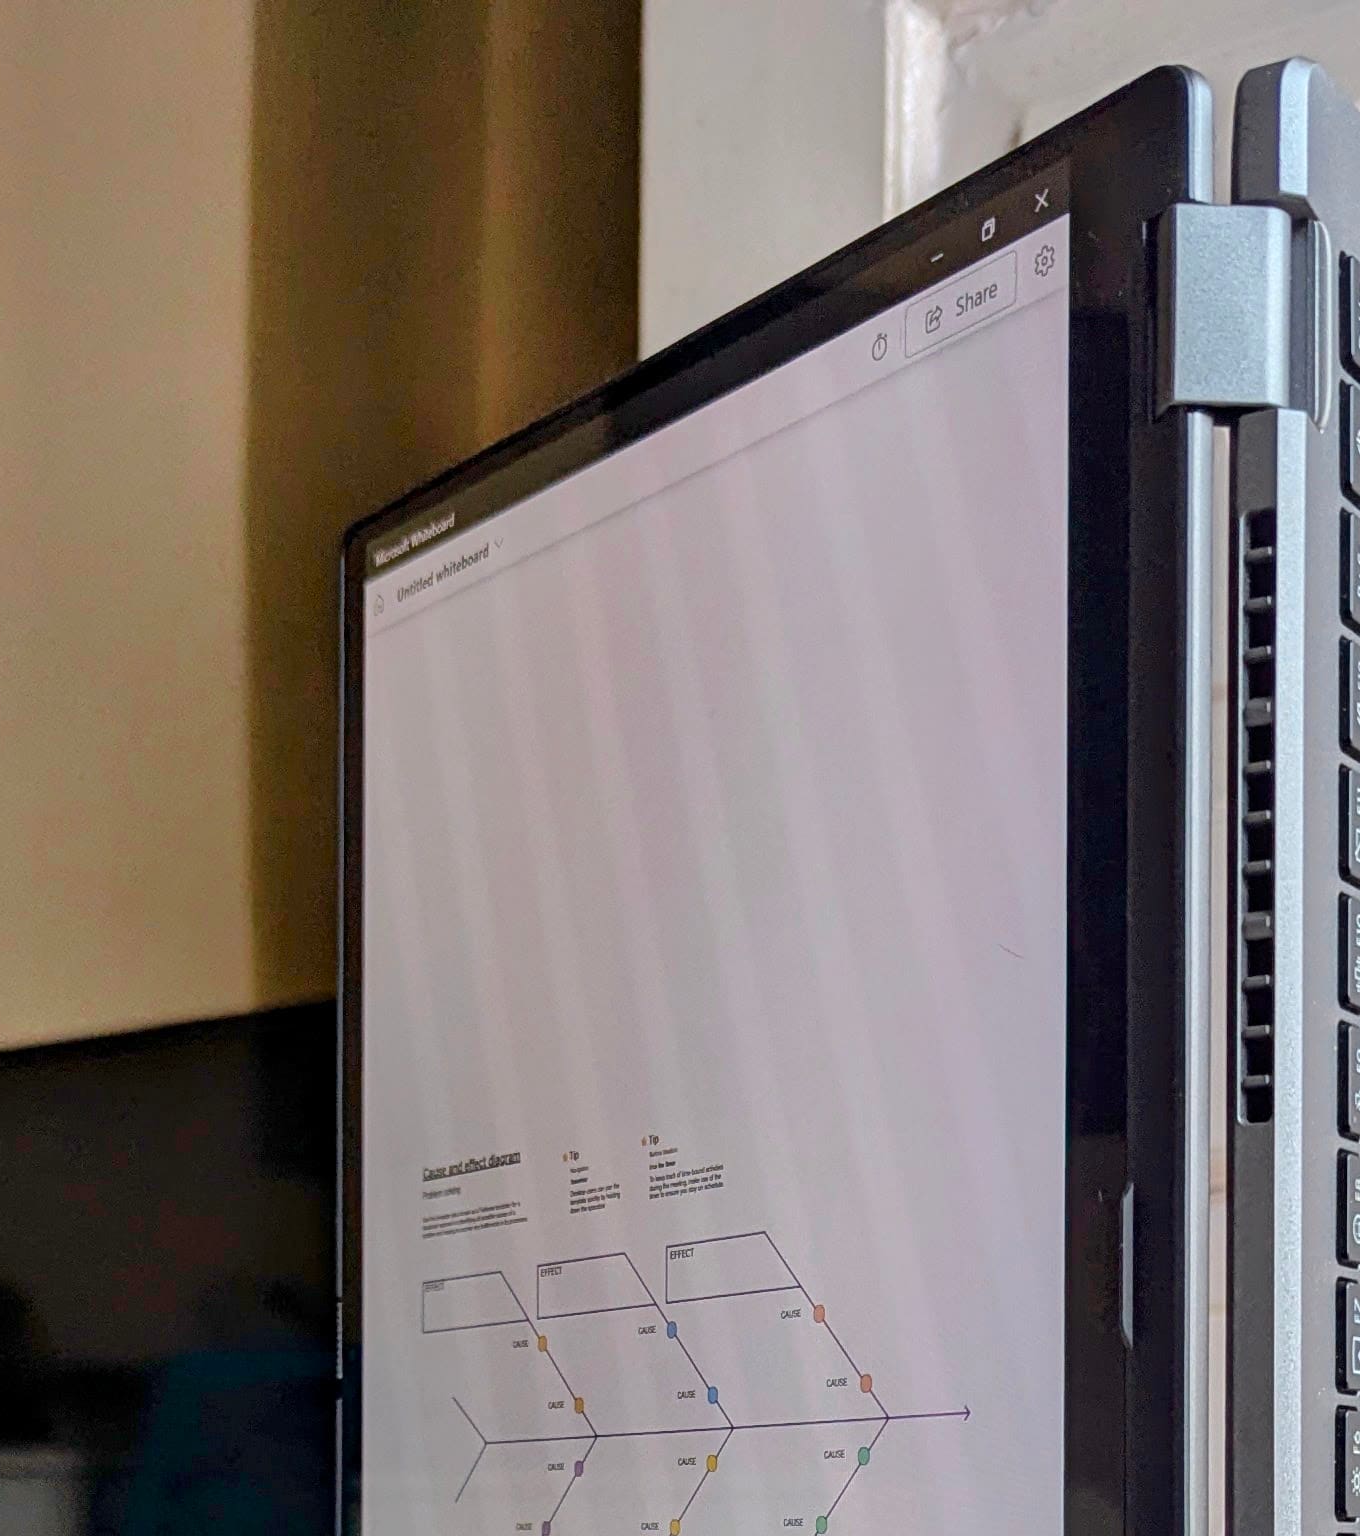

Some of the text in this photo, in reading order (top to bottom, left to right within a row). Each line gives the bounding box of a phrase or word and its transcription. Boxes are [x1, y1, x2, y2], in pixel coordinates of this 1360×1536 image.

[956, 283, 998, 316] Share
[411, 512, 455, 547] Whiteboard
[397, 543, 489, 602] Untitled whiteboard
[649, 1134, 659, 1145] Tip
[423, 1152, 520, 1181] Cause and effect diagram
[670, 1248, 694, 1260] EFFECT
[540, 1266, 562, 1277] EFFECT
[780, 1309, 801, 1319] CAUSE
[638, 1326, 657, 1335] CAUSE
[826, 1378, 848, 1388] CAUSE
[677, 1390, 696, 1399] CAUSE
[548, 1401, 565, 1409] CAUSE
[823, 1450, 846, 1460] CAUSE
[678, 1457, 697, 1466] CAUSE
[641, 1522, 659, 1531] CAUSE
[783, 1518, 804, 1527] CAUSE
